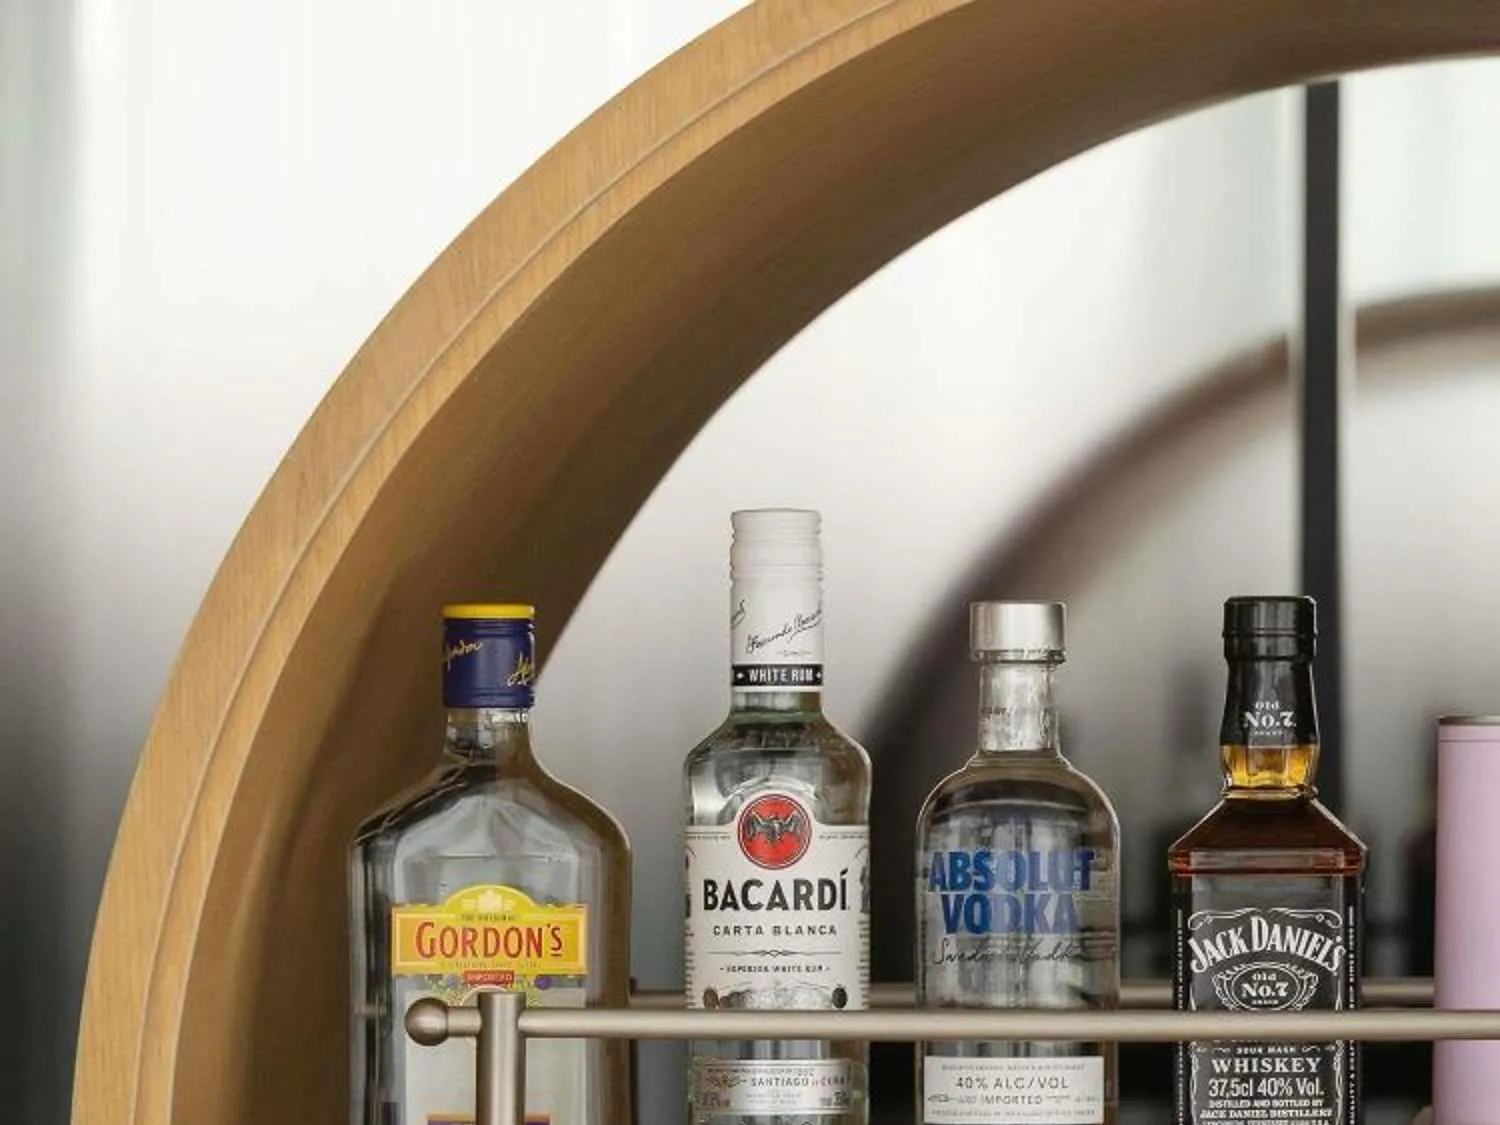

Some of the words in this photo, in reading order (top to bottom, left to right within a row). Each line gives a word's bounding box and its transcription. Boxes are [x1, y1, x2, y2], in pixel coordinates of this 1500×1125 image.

[748, 668, 788, 682] WHITE
[791, 668, 813, 682] RUM
[928, 850, 1095, 892] ABSOLUT
[702, 868, 849, 911] BACARDÍ
[939, 893, 1081, 934] VODKA
[712, 924, 765, 936] CARTA
[772, 924, 838, 936] BLANCA
[415, 921, 564, 958] GORDON'S
[1187, 927, 1249, 973] JACK
[1251, 916, 1347, 976] DANIEL'S
[1252, 972, 1277, 981] Old
[1210, 1056, 1322, 1073] WHISKEY
[955, 1077, 989, 1091] 40%
[993, 1076, 1071, 1091] ALC/VOL
[1257, 1077, 1293, 1097] 40%
[1295, 1077, 1325, 1097] Vol.
[983, 1095, 1044, 1105] IMPORTED
